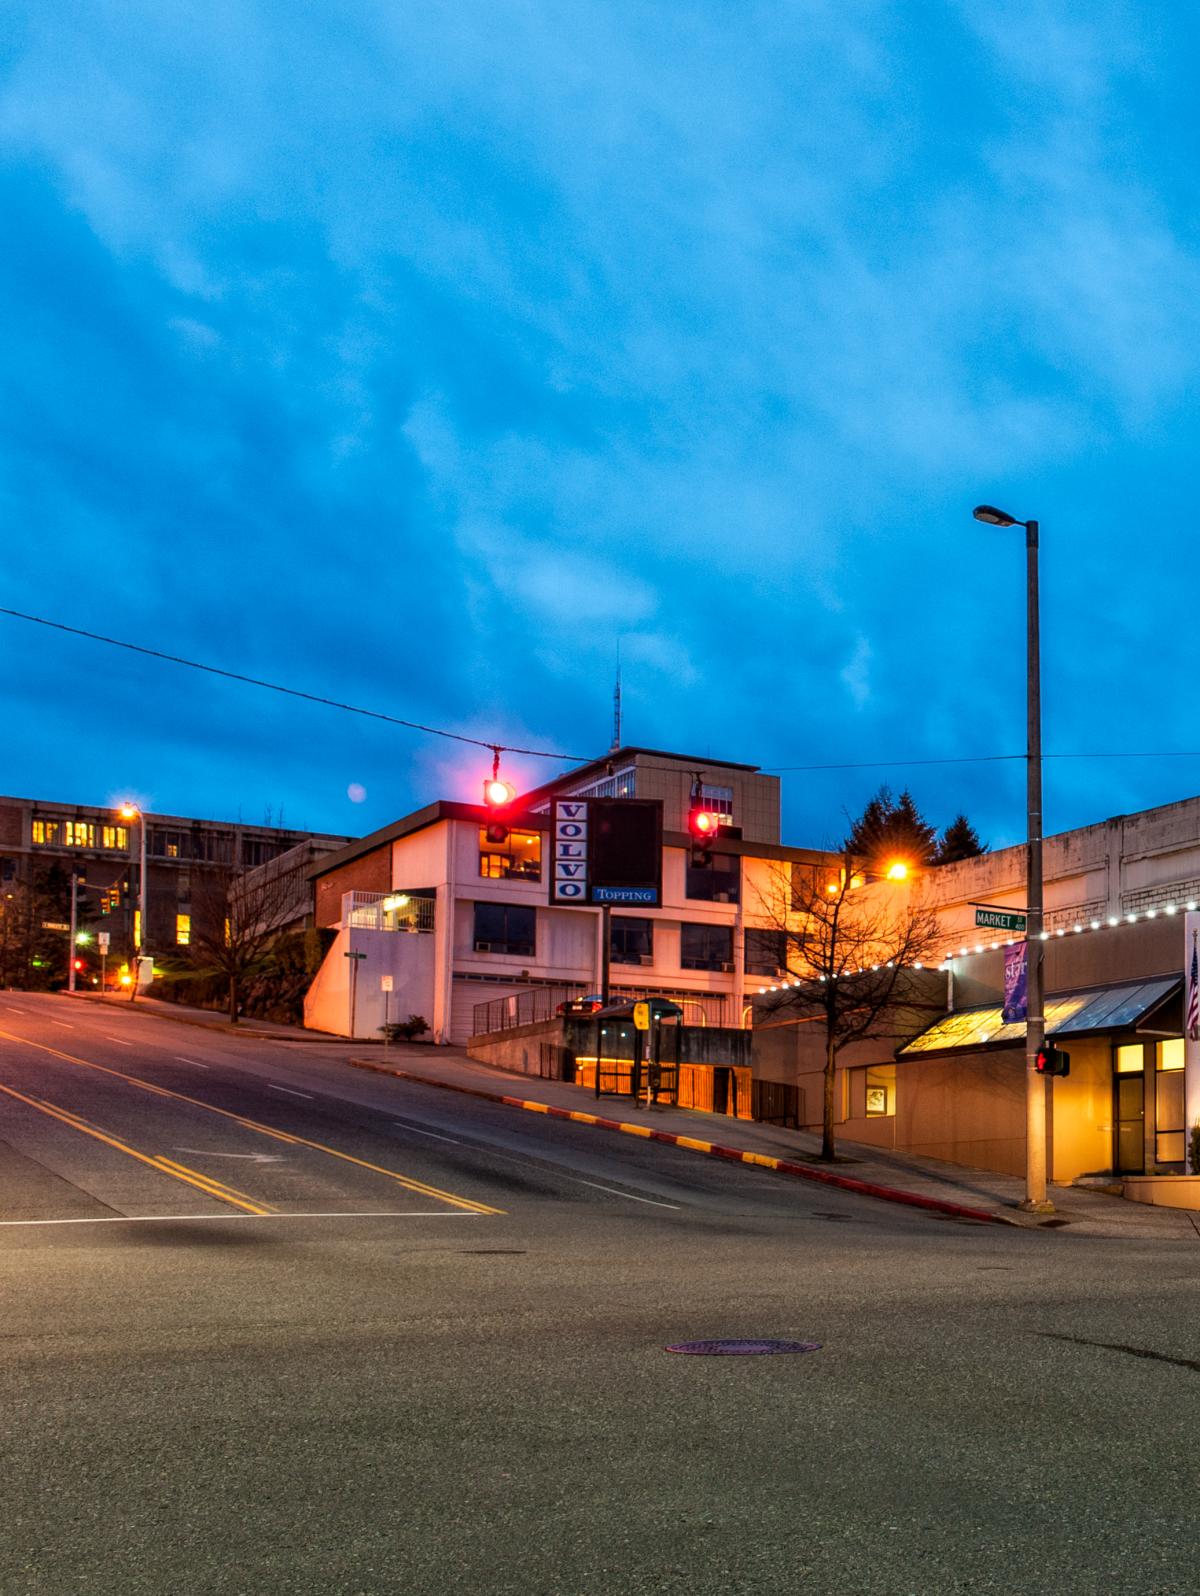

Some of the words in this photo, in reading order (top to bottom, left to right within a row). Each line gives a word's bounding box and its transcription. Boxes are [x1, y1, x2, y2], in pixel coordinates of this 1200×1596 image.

[558, 804, 584, 897] VOLVO
[597, 888, 651, 900] TOPPING
[976, 911, 1011, 927] MARKET
